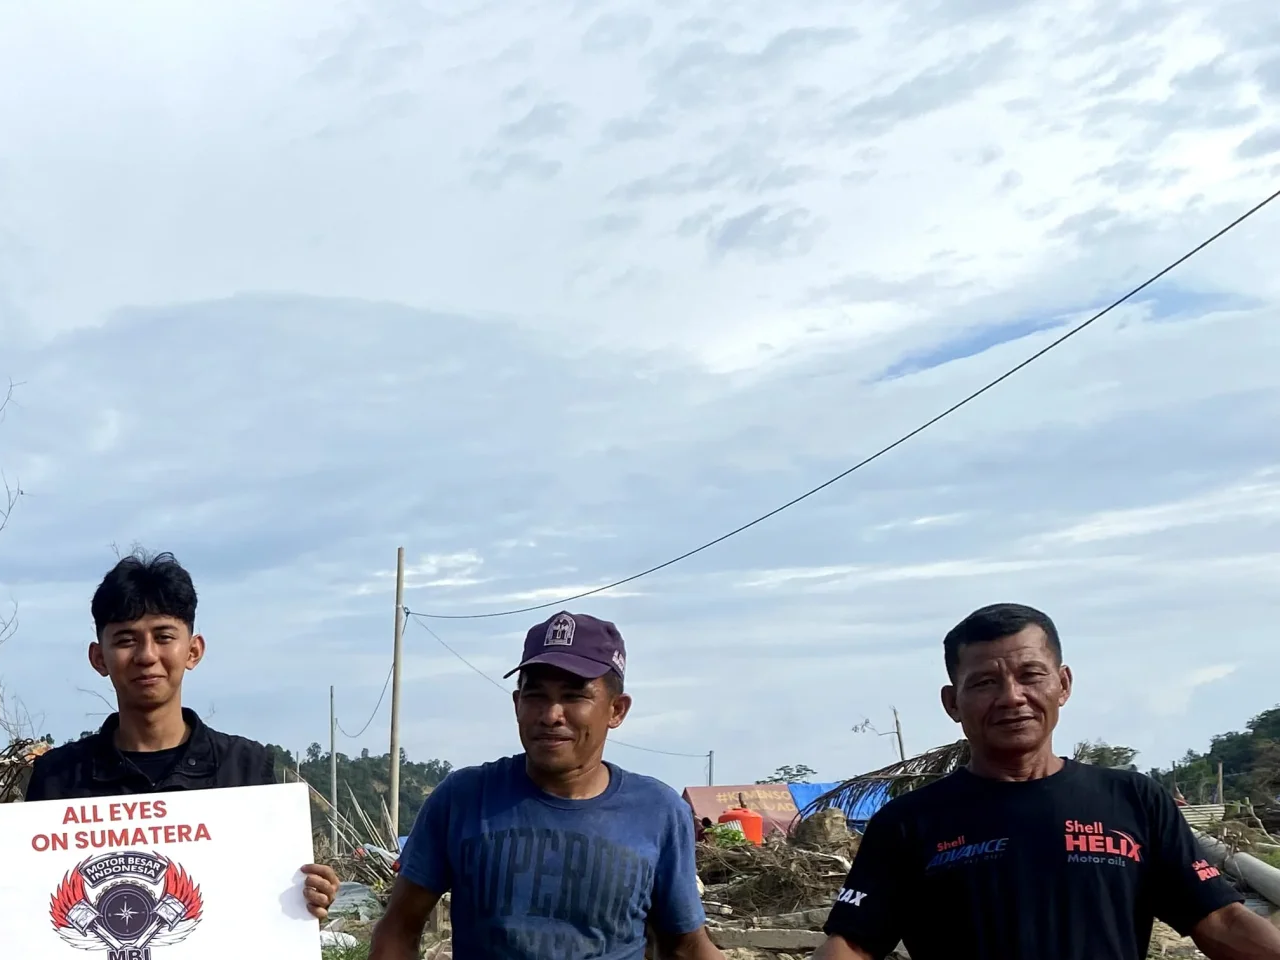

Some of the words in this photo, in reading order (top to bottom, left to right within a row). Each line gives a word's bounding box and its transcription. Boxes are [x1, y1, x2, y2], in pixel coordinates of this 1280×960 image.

[62, 805, 104, 825] ALL
[109, 800, 167, 822] EYES
[1064, 820, 1104, 834] Shell
[31, 832, 68, 852] ON
[74, 823, 212, 850] SUMATERA
[937, 835, 966, 851] Shell
[1064, 831, 1142, 862] HELIX
[925, 837, 1009, 869] ADVANCE
[1067, 854, 1106, 864] Motor
[1108, 856, 1127, 868] oils
[86, 857, 125, 876] MOTOR
[127, 857, 161, 871] BESAR
[91, 865, 155, 881] INDONESIA
